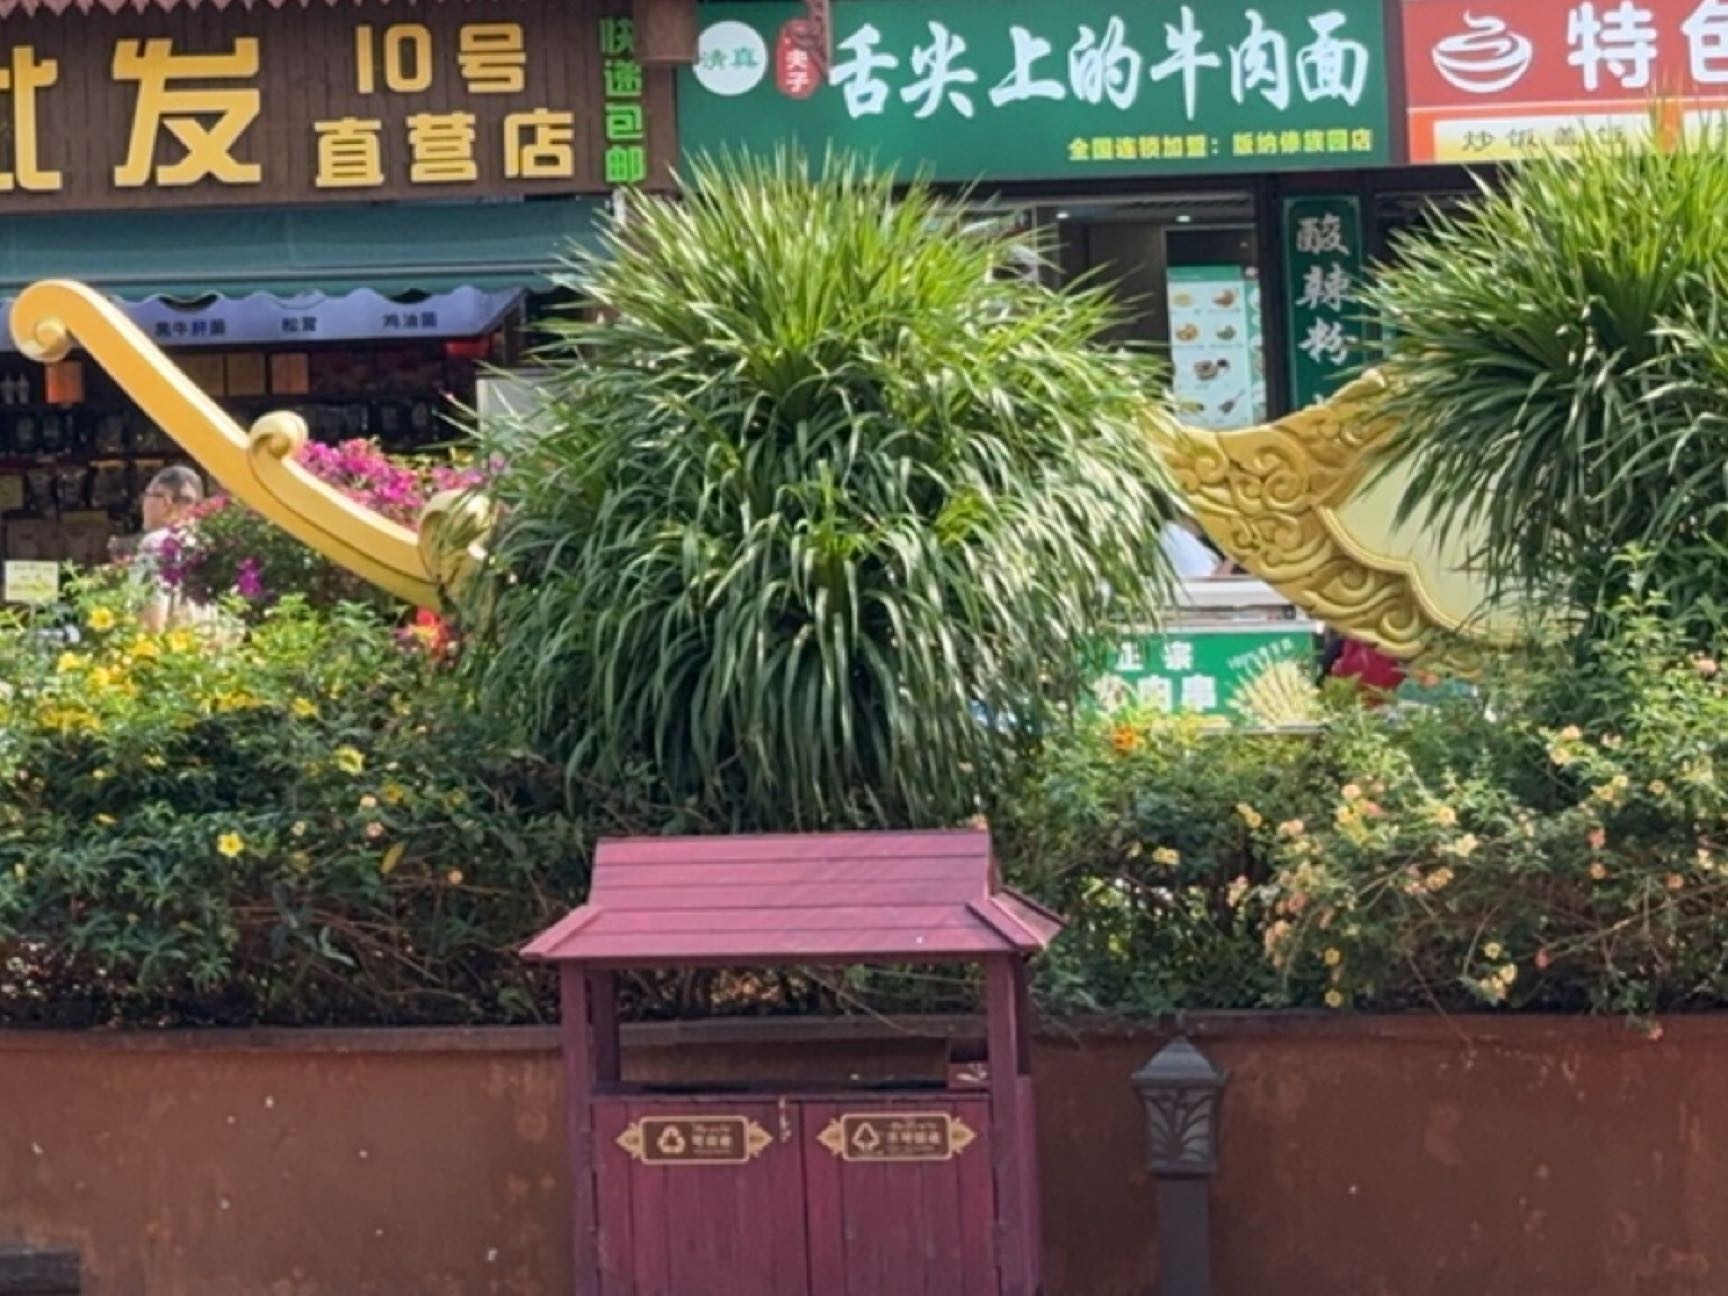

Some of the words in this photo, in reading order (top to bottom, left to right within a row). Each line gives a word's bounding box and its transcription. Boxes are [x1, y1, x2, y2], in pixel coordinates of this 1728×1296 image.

[355, 23, 526, 94] 10号
[599, 17, 647, 183] 快递包邮
[829, 5, 1369, 120] 舌尖上的牛肉面
[314, 108, 575, 188] 直营店
[1294, 211, 1360, 406] 酸辣粉
